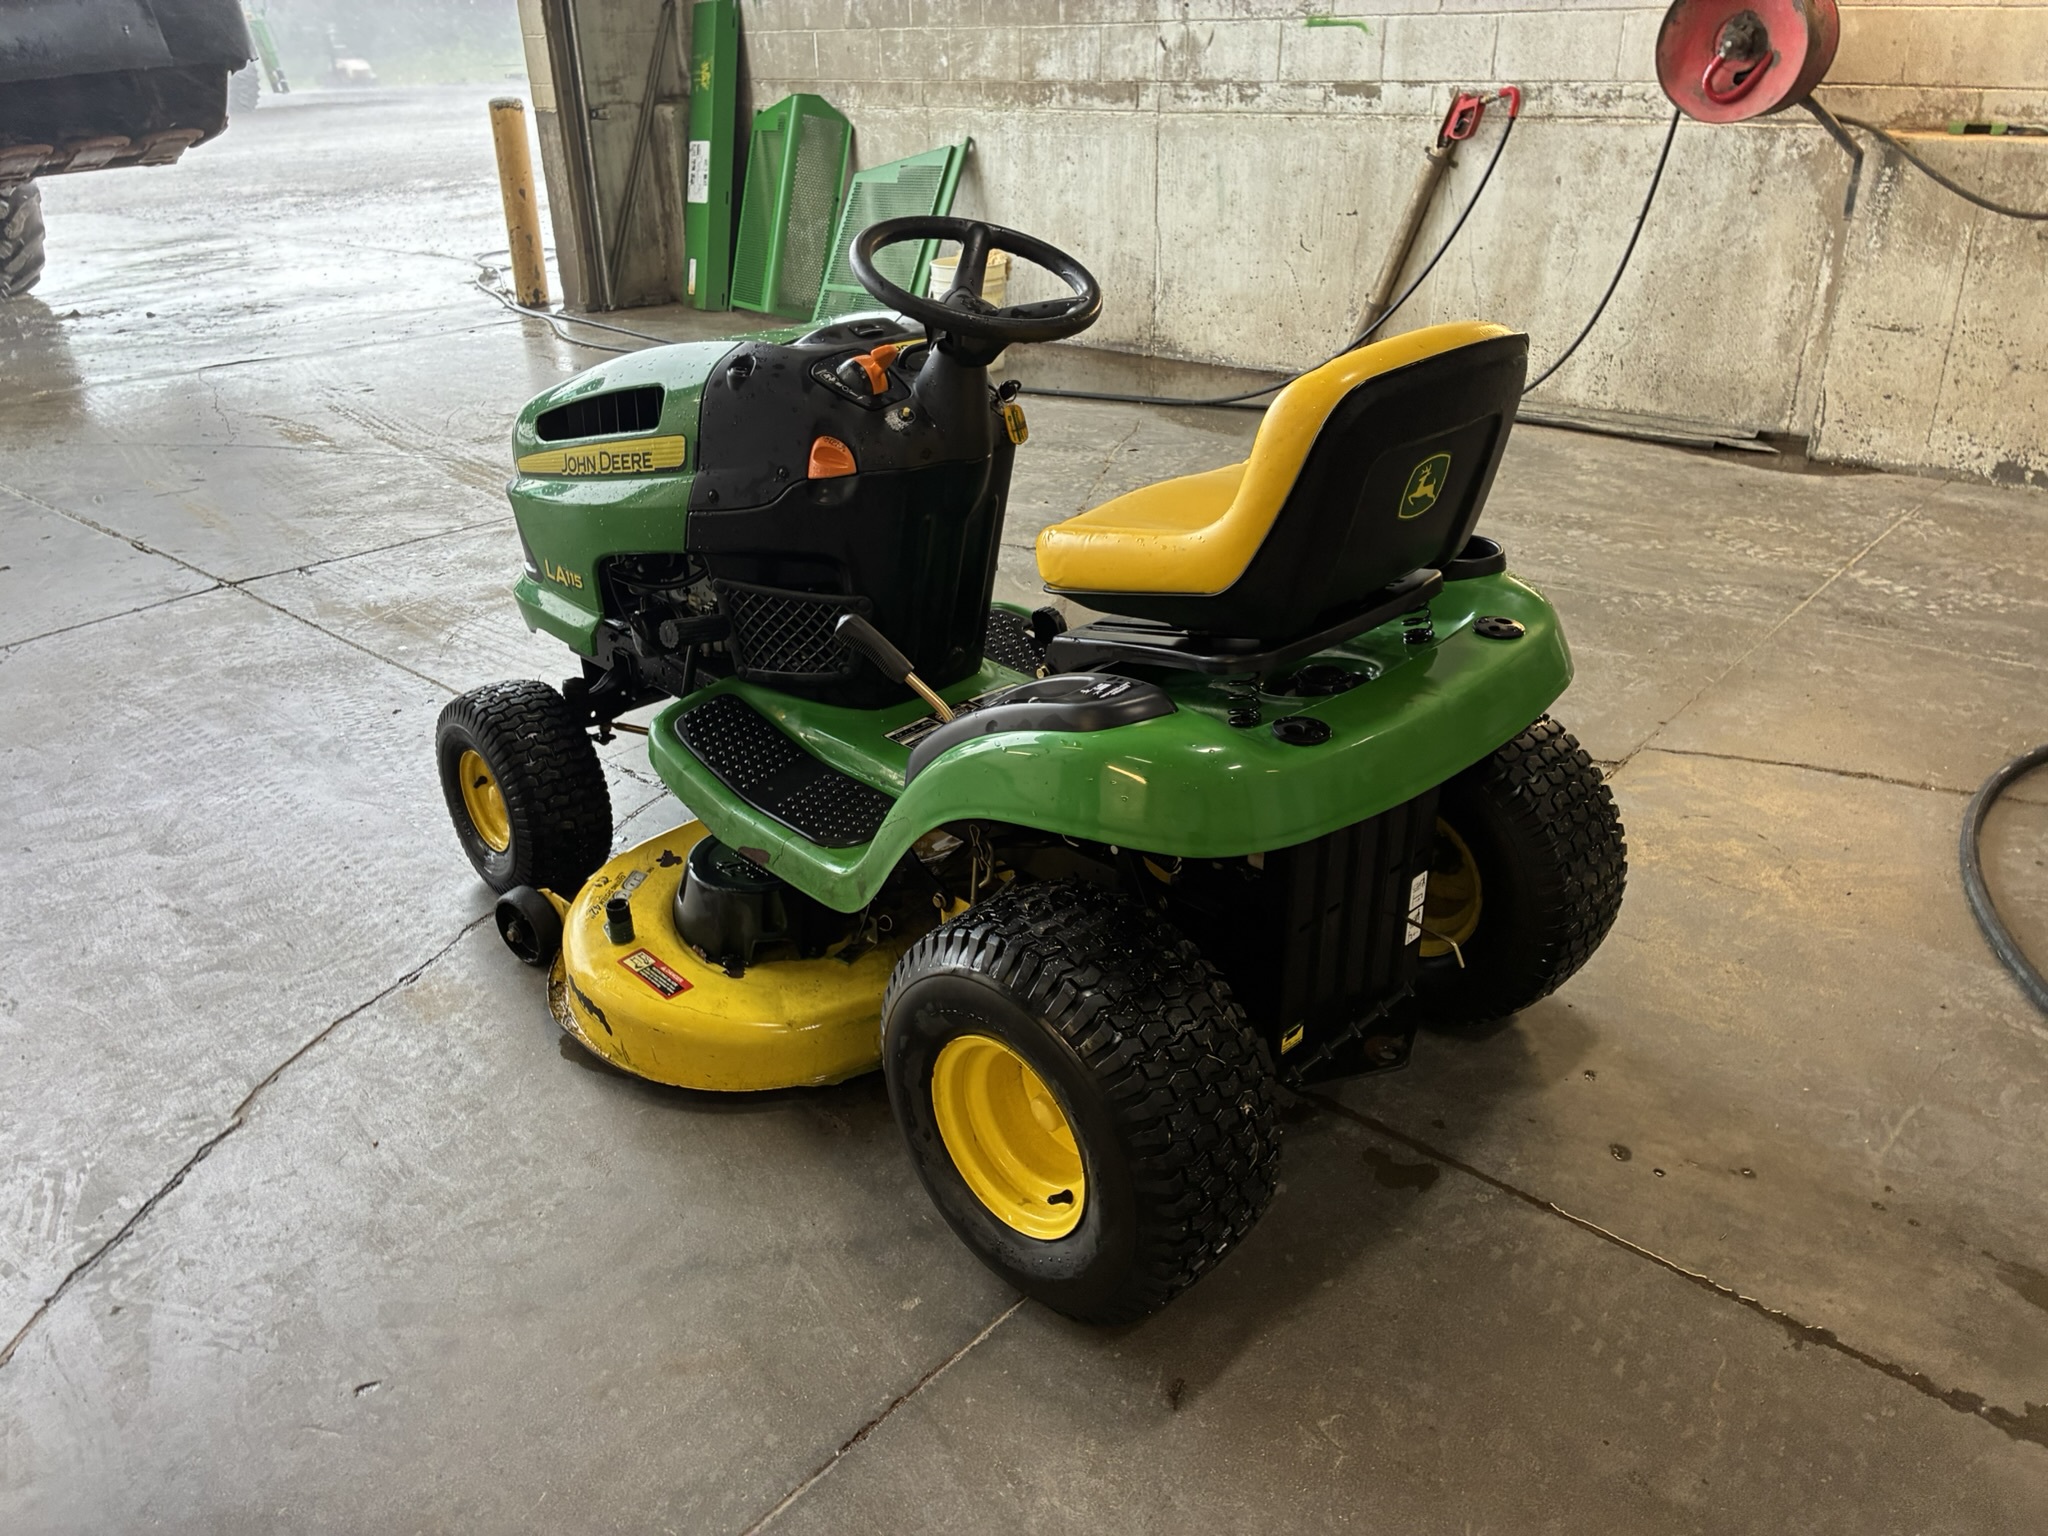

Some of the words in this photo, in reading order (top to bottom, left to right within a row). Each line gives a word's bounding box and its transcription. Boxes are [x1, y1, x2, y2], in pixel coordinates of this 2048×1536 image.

[561, 453, 597, 474] JOHN
[599, 450, 654, 472] DEERE
[544, 557, 584, 589] LA115
